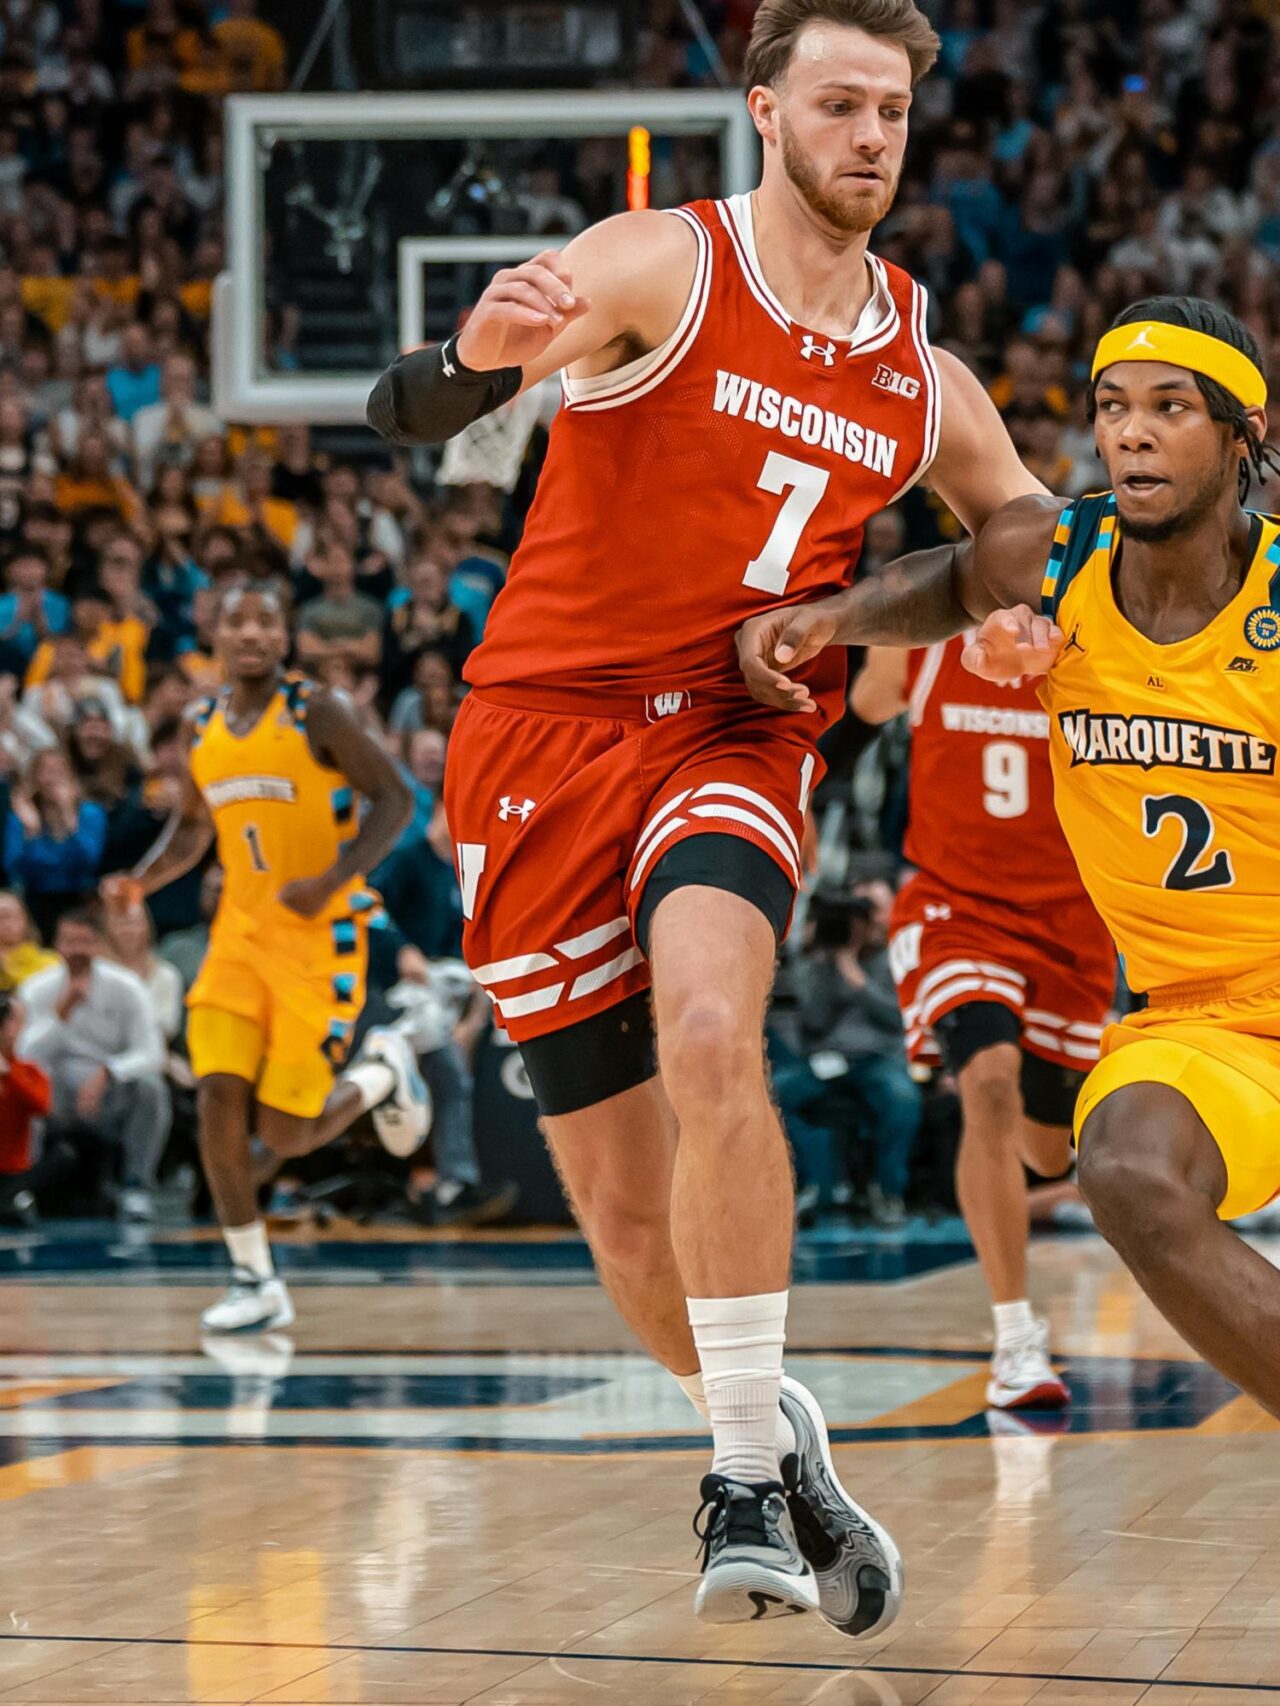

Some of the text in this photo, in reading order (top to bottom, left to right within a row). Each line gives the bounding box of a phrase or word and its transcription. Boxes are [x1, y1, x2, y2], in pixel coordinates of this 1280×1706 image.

[871, 363, 921, 400] BIG
[712, 368, 898, 478] WISCONSIN
[741, 450, 831, 597] 7
[653, 691, 684, 717] W
[941, 703, 1049, 739] WISCONS
[1058, 708, 1278, 776] MARQUETTE
[982, 739, 1030, 820] 9
[243, 822, 271, 872] 1
[1140, 793, 1236, 891] 2
